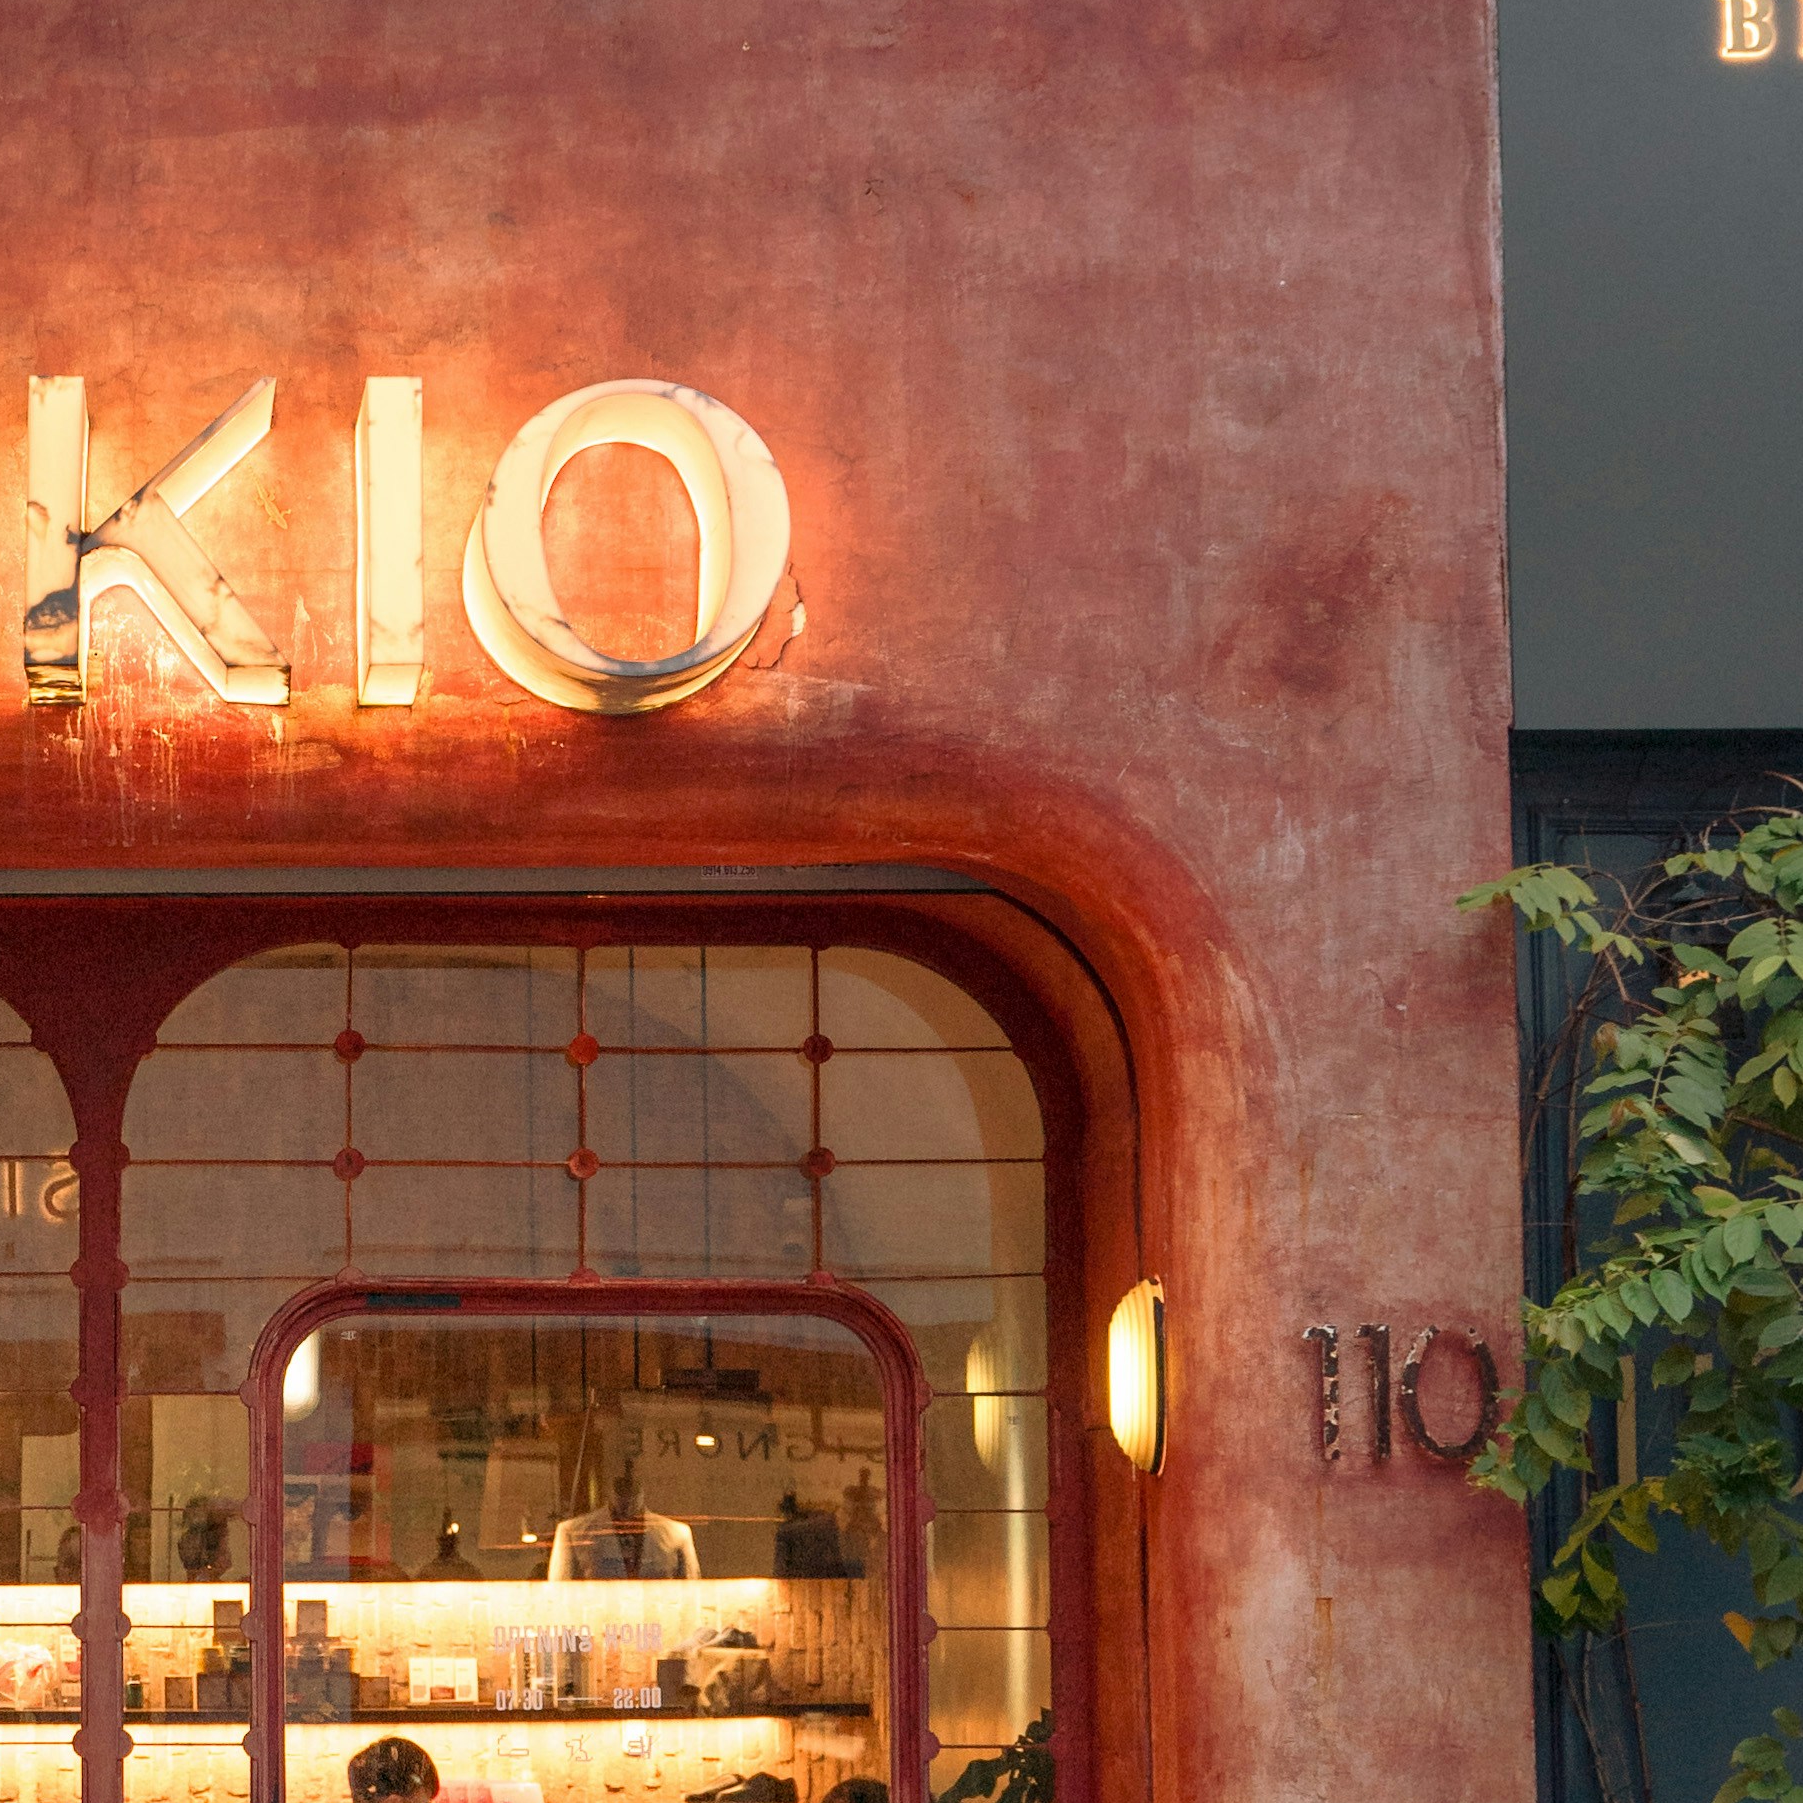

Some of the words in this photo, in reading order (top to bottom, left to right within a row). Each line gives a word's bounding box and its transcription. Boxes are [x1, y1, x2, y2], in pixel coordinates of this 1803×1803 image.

[1302, 1324, 1499, 1461] 110
[496, 1689, 543, 1711] 07:30
[613, 1687, 662, 1709] 22:00
